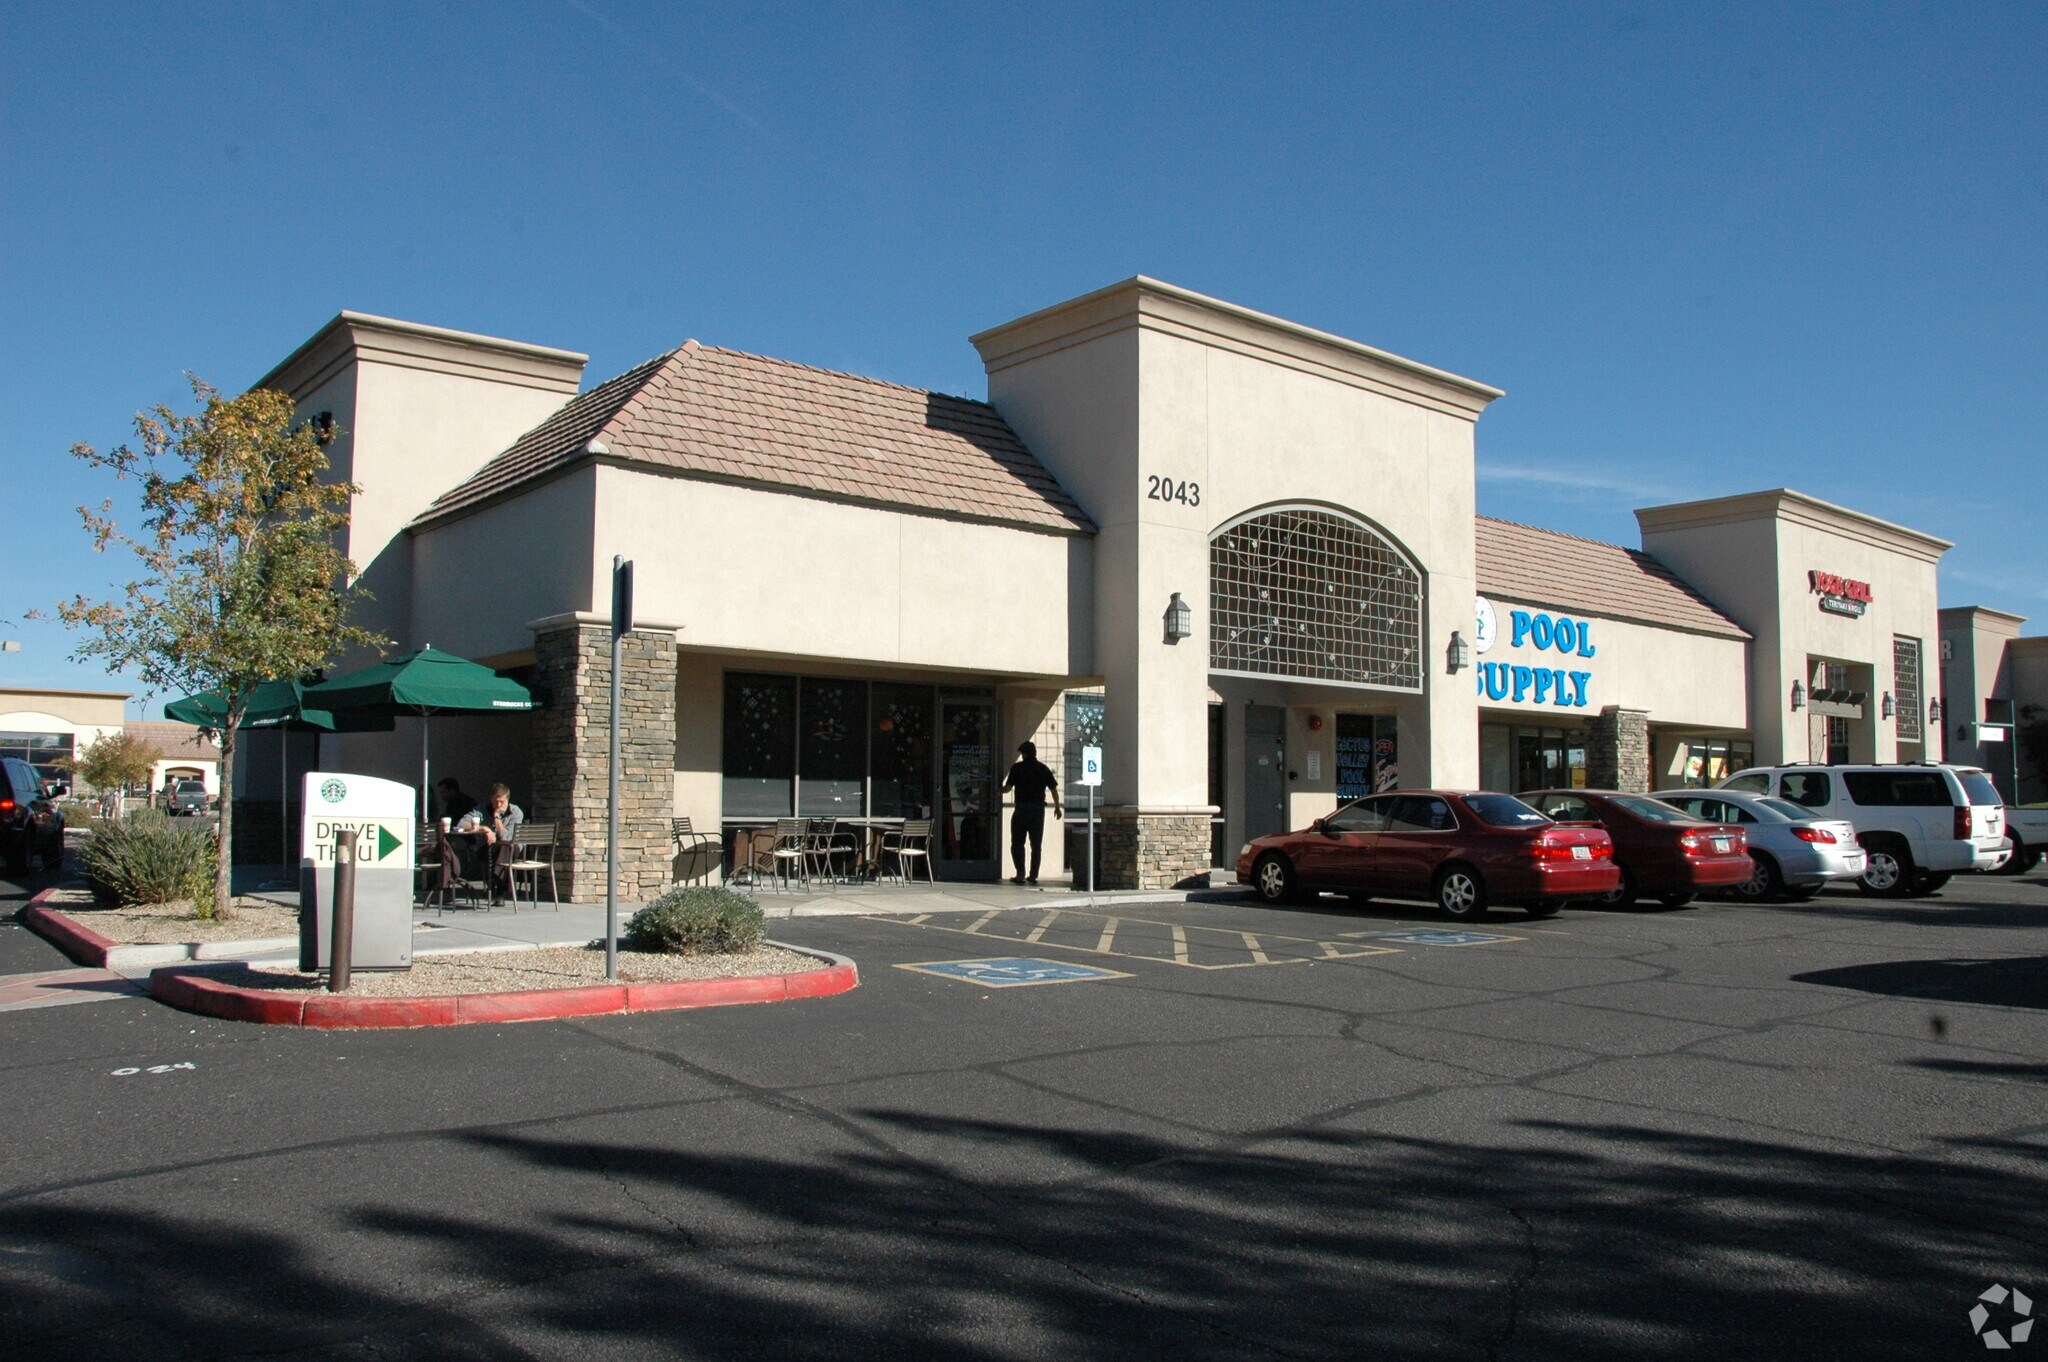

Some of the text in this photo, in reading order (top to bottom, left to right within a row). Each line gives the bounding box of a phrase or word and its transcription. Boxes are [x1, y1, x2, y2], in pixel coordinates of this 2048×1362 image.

[1148, 475, 1200, 507] 2043
[1510, 610, 1595, 658] POOL
[1341, 768, 1366, 784] POOL
[315, 844, 372, 861] THU
